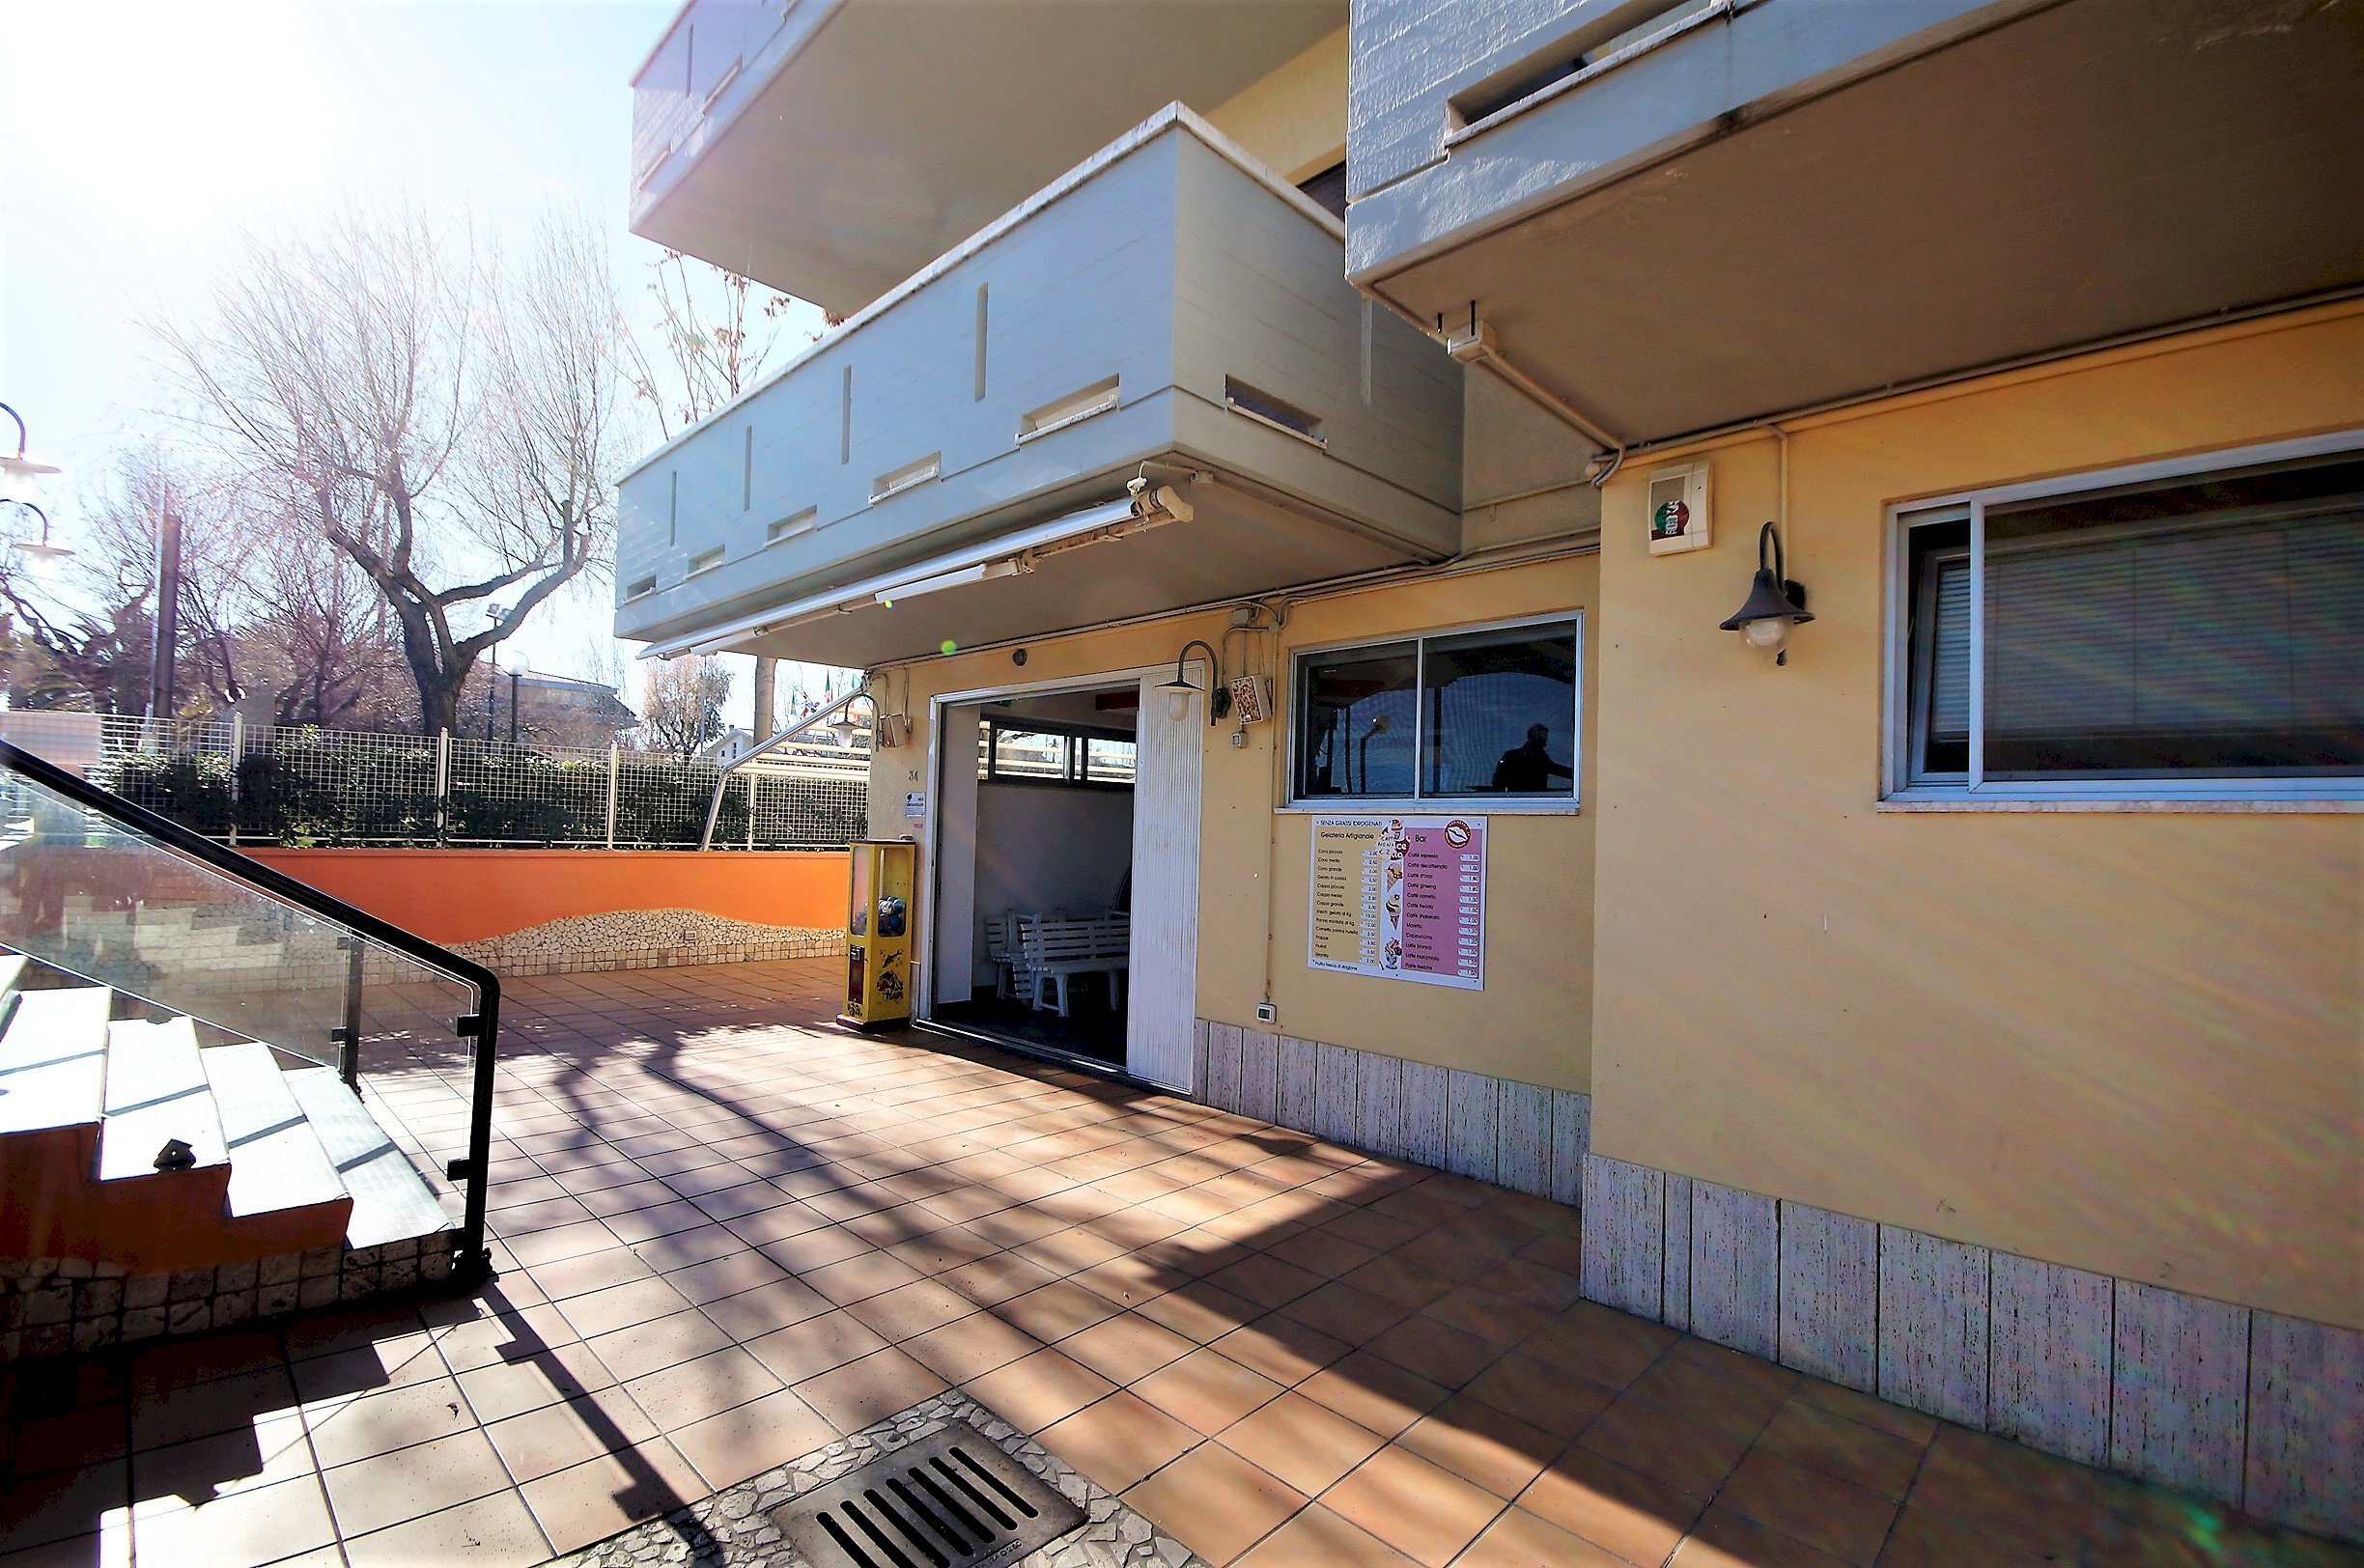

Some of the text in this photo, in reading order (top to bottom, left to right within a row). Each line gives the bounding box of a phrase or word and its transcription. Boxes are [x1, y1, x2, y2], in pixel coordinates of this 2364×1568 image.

[909, 770, 918, 781] 34
[1345, 832, 1375, 841] Artigianale
[1415, 834, 1427, 843] Bar
